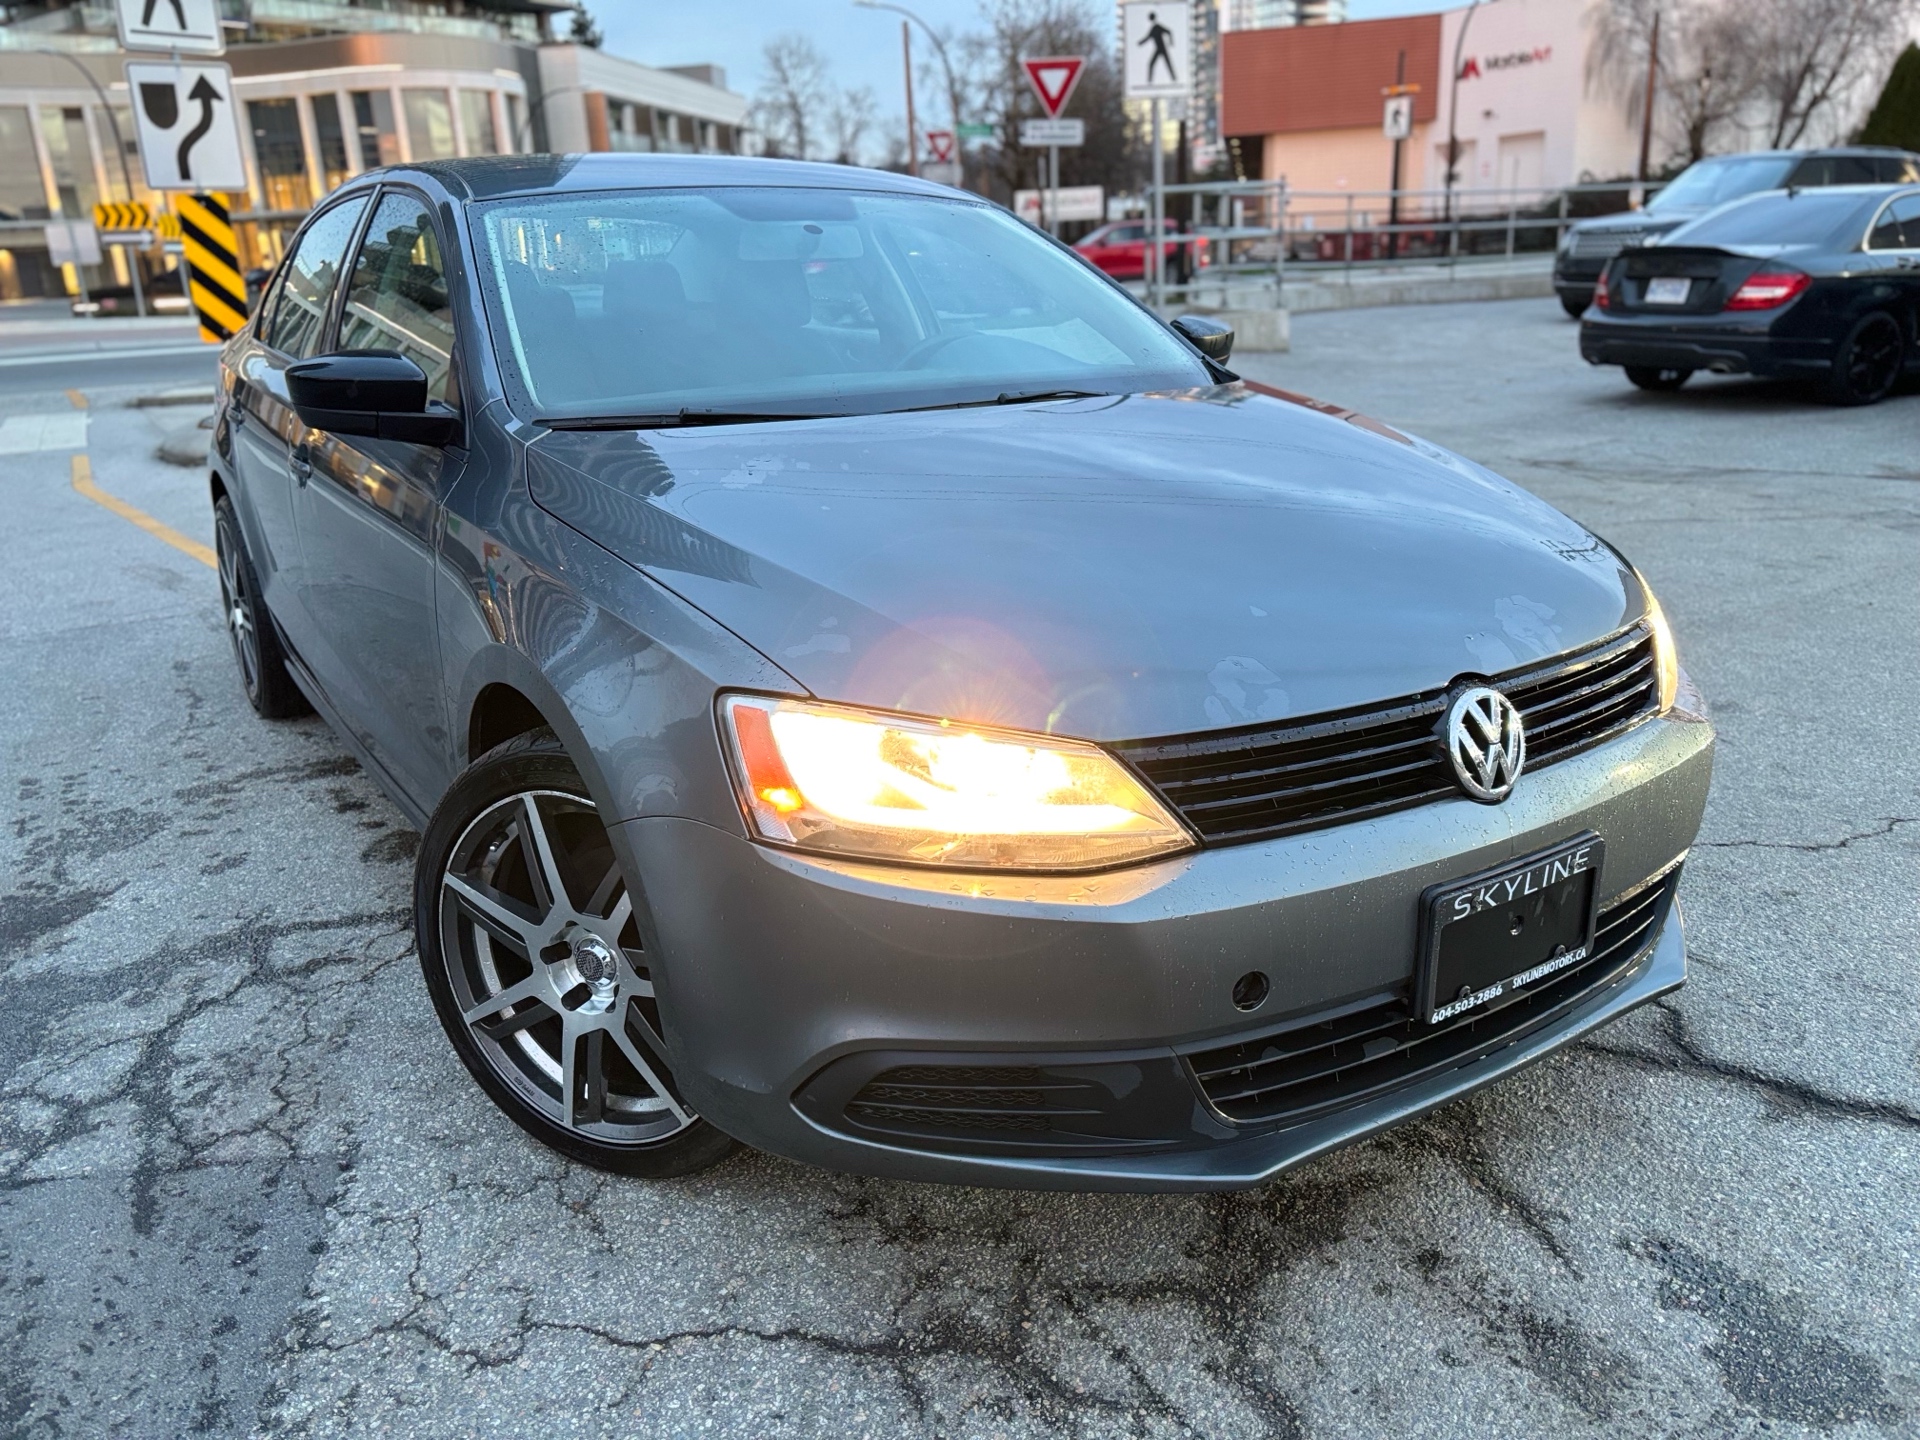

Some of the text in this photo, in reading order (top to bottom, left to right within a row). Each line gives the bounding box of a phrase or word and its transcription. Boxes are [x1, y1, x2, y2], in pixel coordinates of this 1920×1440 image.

[1453, 847, 1591, 921] SKYLINE
[1431, 947, 1587, 1024] 604-503-2886 SKYLINEMOTORS.CA
